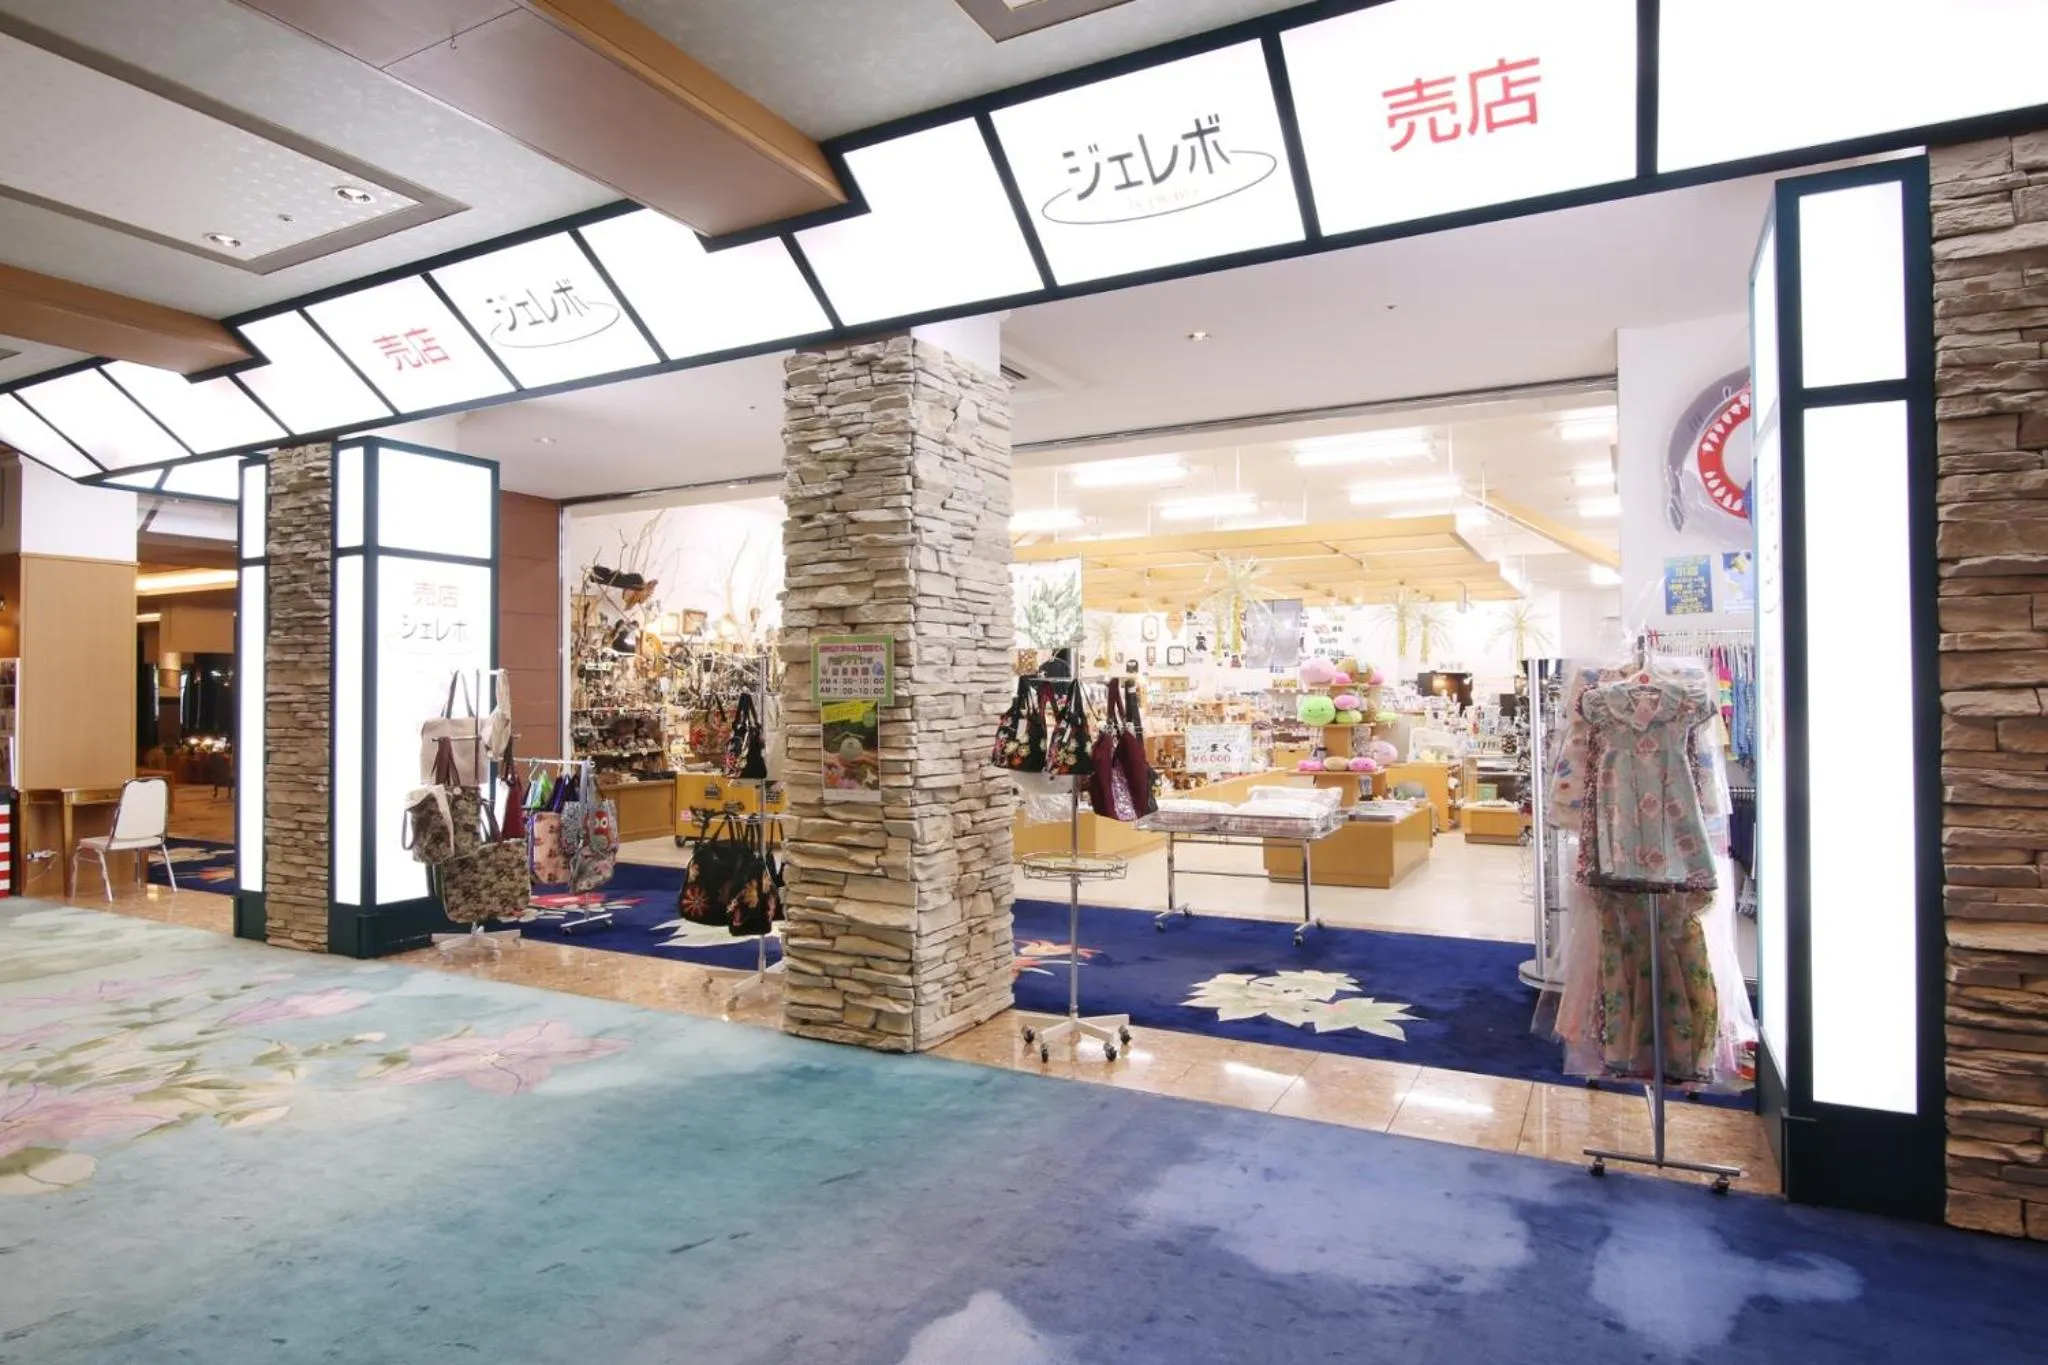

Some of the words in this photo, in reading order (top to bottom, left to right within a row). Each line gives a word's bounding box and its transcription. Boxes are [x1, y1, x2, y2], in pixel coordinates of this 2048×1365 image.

[1381, 57, 1542, 151] 売店
[1062, 113, 1231, 201] ジェレボ
[486, 278, 591, 332] ジェレボ
[373, 327, 450, 371] 売店
[412, 581, 460, 608] 売店
